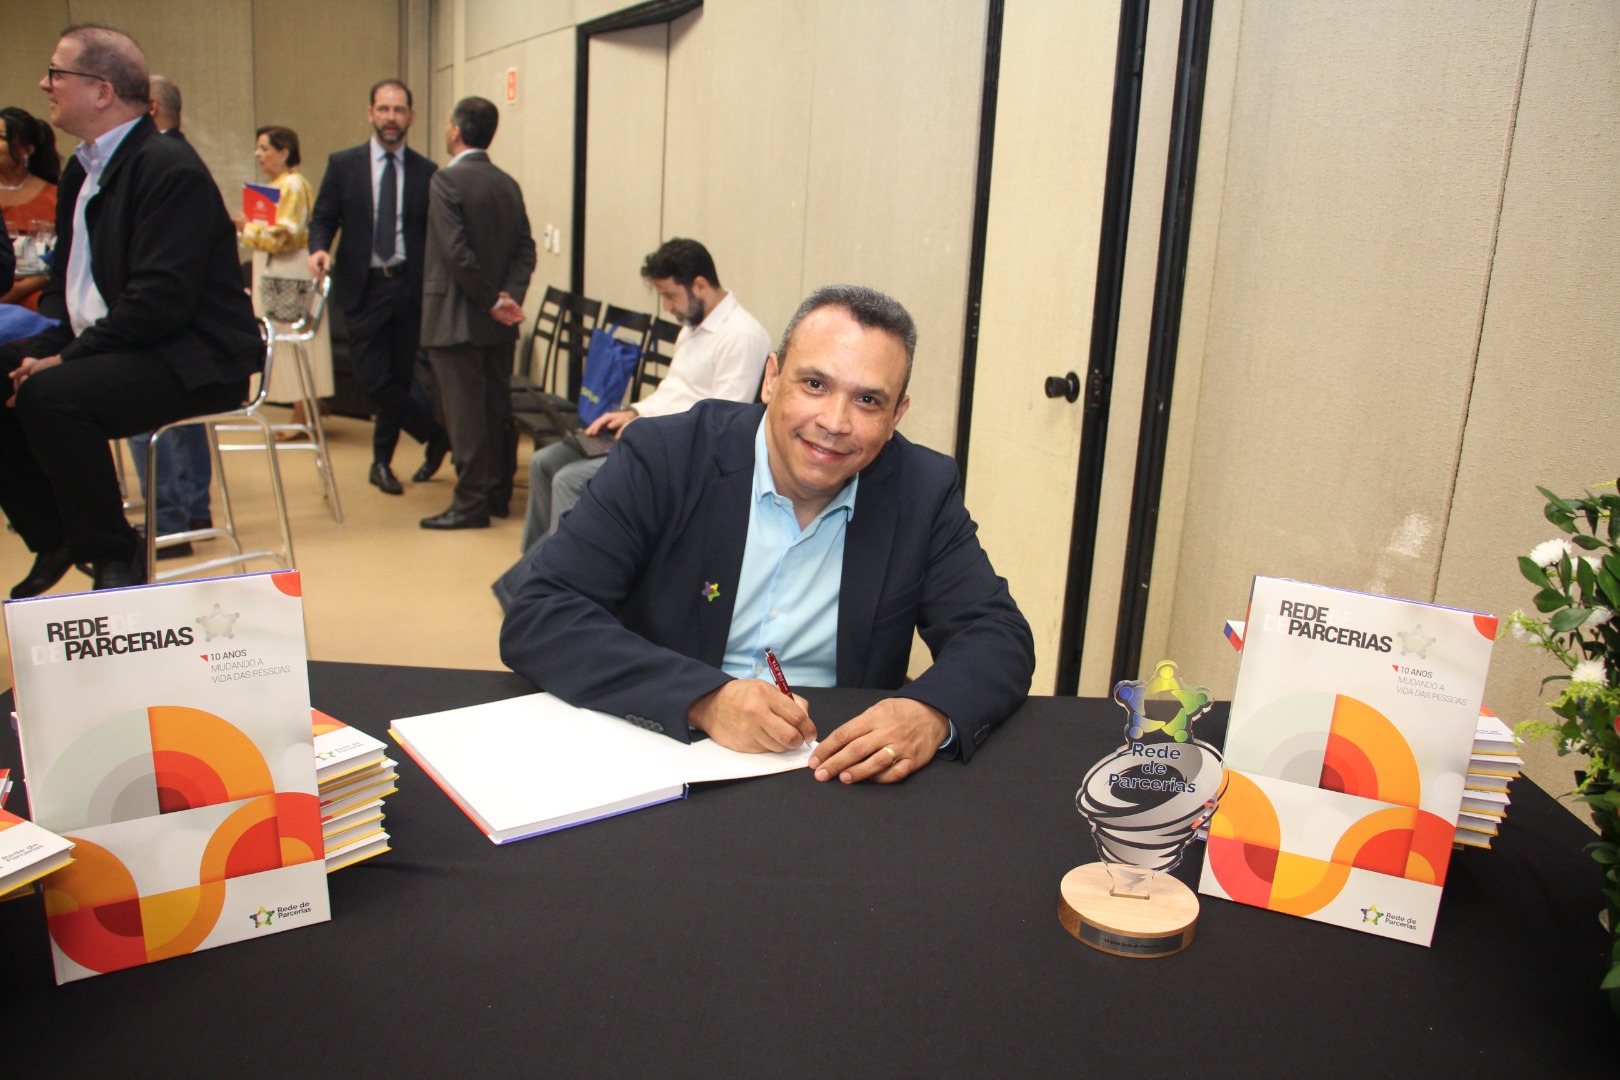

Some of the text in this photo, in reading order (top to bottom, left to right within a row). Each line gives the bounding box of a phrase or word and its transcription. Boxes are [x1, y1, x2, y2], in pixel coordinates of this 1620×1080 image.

[1279, 600, 1329, 623] REDE
[46, 616, 110, 642] REDE
[1288, 619, 1393, 652] PARCERIAS
[64, 626, 194, 661] PARCERIAS
[210, 650, 246, 661] 10 ANOS
[211, 659, 256, 672] MUDANDO
[1400, 666, 1432, 678] 10 ANOS
[212, 665, 291, 683] VIDA DAS PESSOAS
[1398, 676, 1438, 690] MUDANDO
[1396, 686, 1468, 706] VIDA DAS PESSOAS
[1132, 742, 1181, 760] Rede
[1141, 760, 1167, 774] de
[1108, 773, 1196, 793] Parcerias
[277, 904, 297, 913] Rede
[278, 907, 312, 918] Parcerias
[1386, 912, 1405, 921] Rede
[1385, 918, 1416, 930] Parcerias
